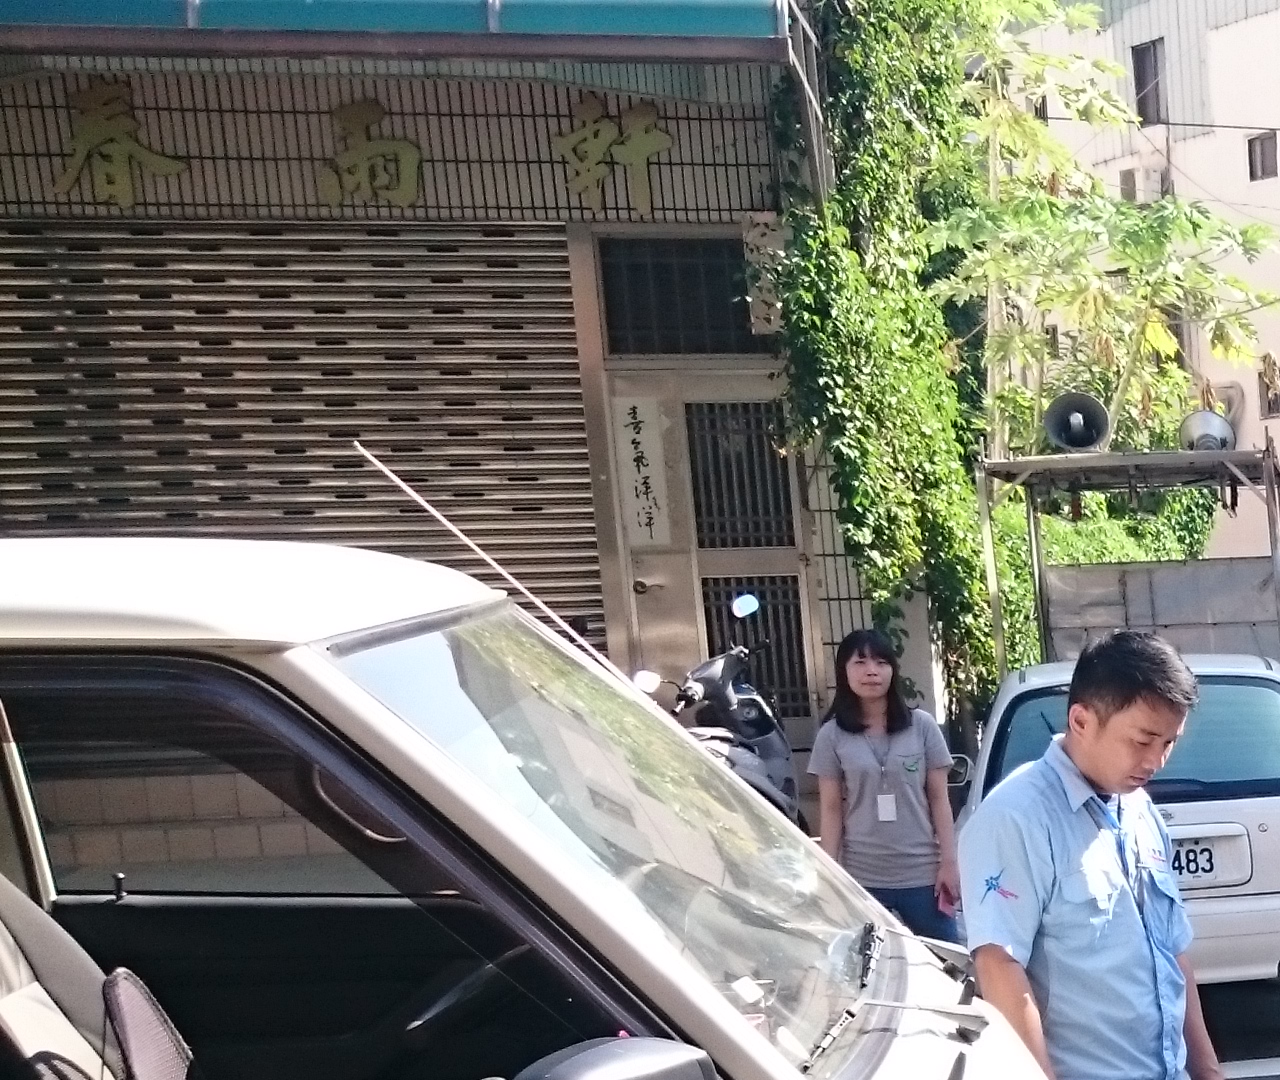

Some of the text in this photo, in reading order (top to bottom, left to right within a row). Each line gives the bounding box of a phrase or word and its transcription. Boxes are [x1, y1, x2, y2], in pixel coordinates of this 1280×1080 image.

[53, 82, 674, 216] 春雨軒
[1171, 847, 1214, 875] 483
